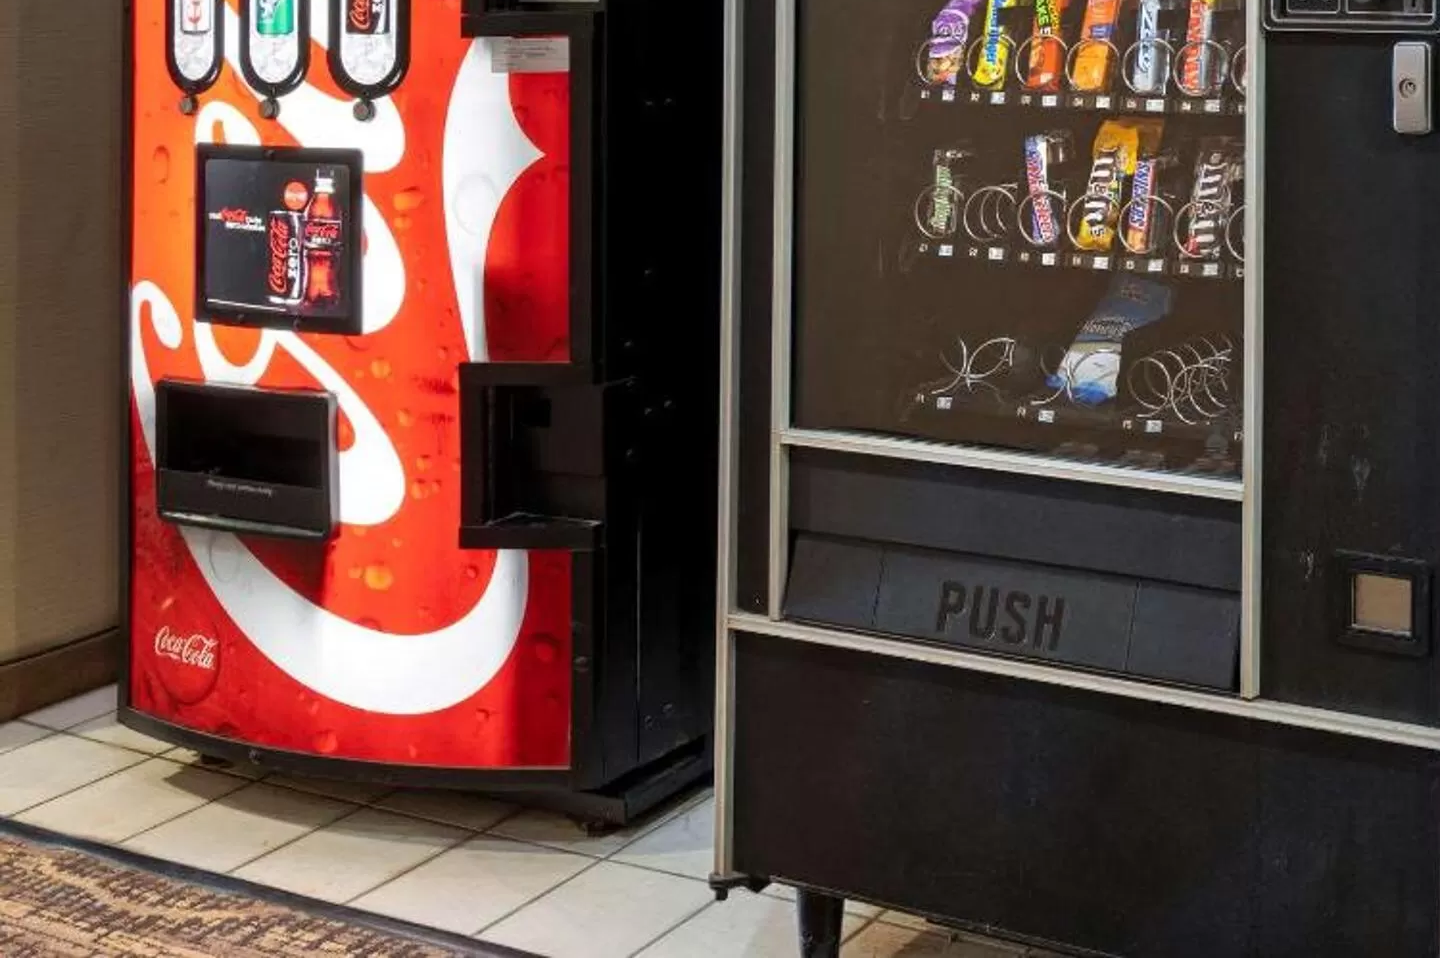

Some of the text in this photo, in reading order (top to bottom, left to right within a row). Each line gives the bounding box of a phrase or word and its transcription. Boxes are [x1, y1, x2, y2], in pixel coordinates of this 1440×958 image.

[269, 217, 289, 293] Coca-Cola
[287, 237, 299, 278] zero
[937, 580, 1066, 651] PUSH
[155, 625, 219, 670] Coca-Cola
